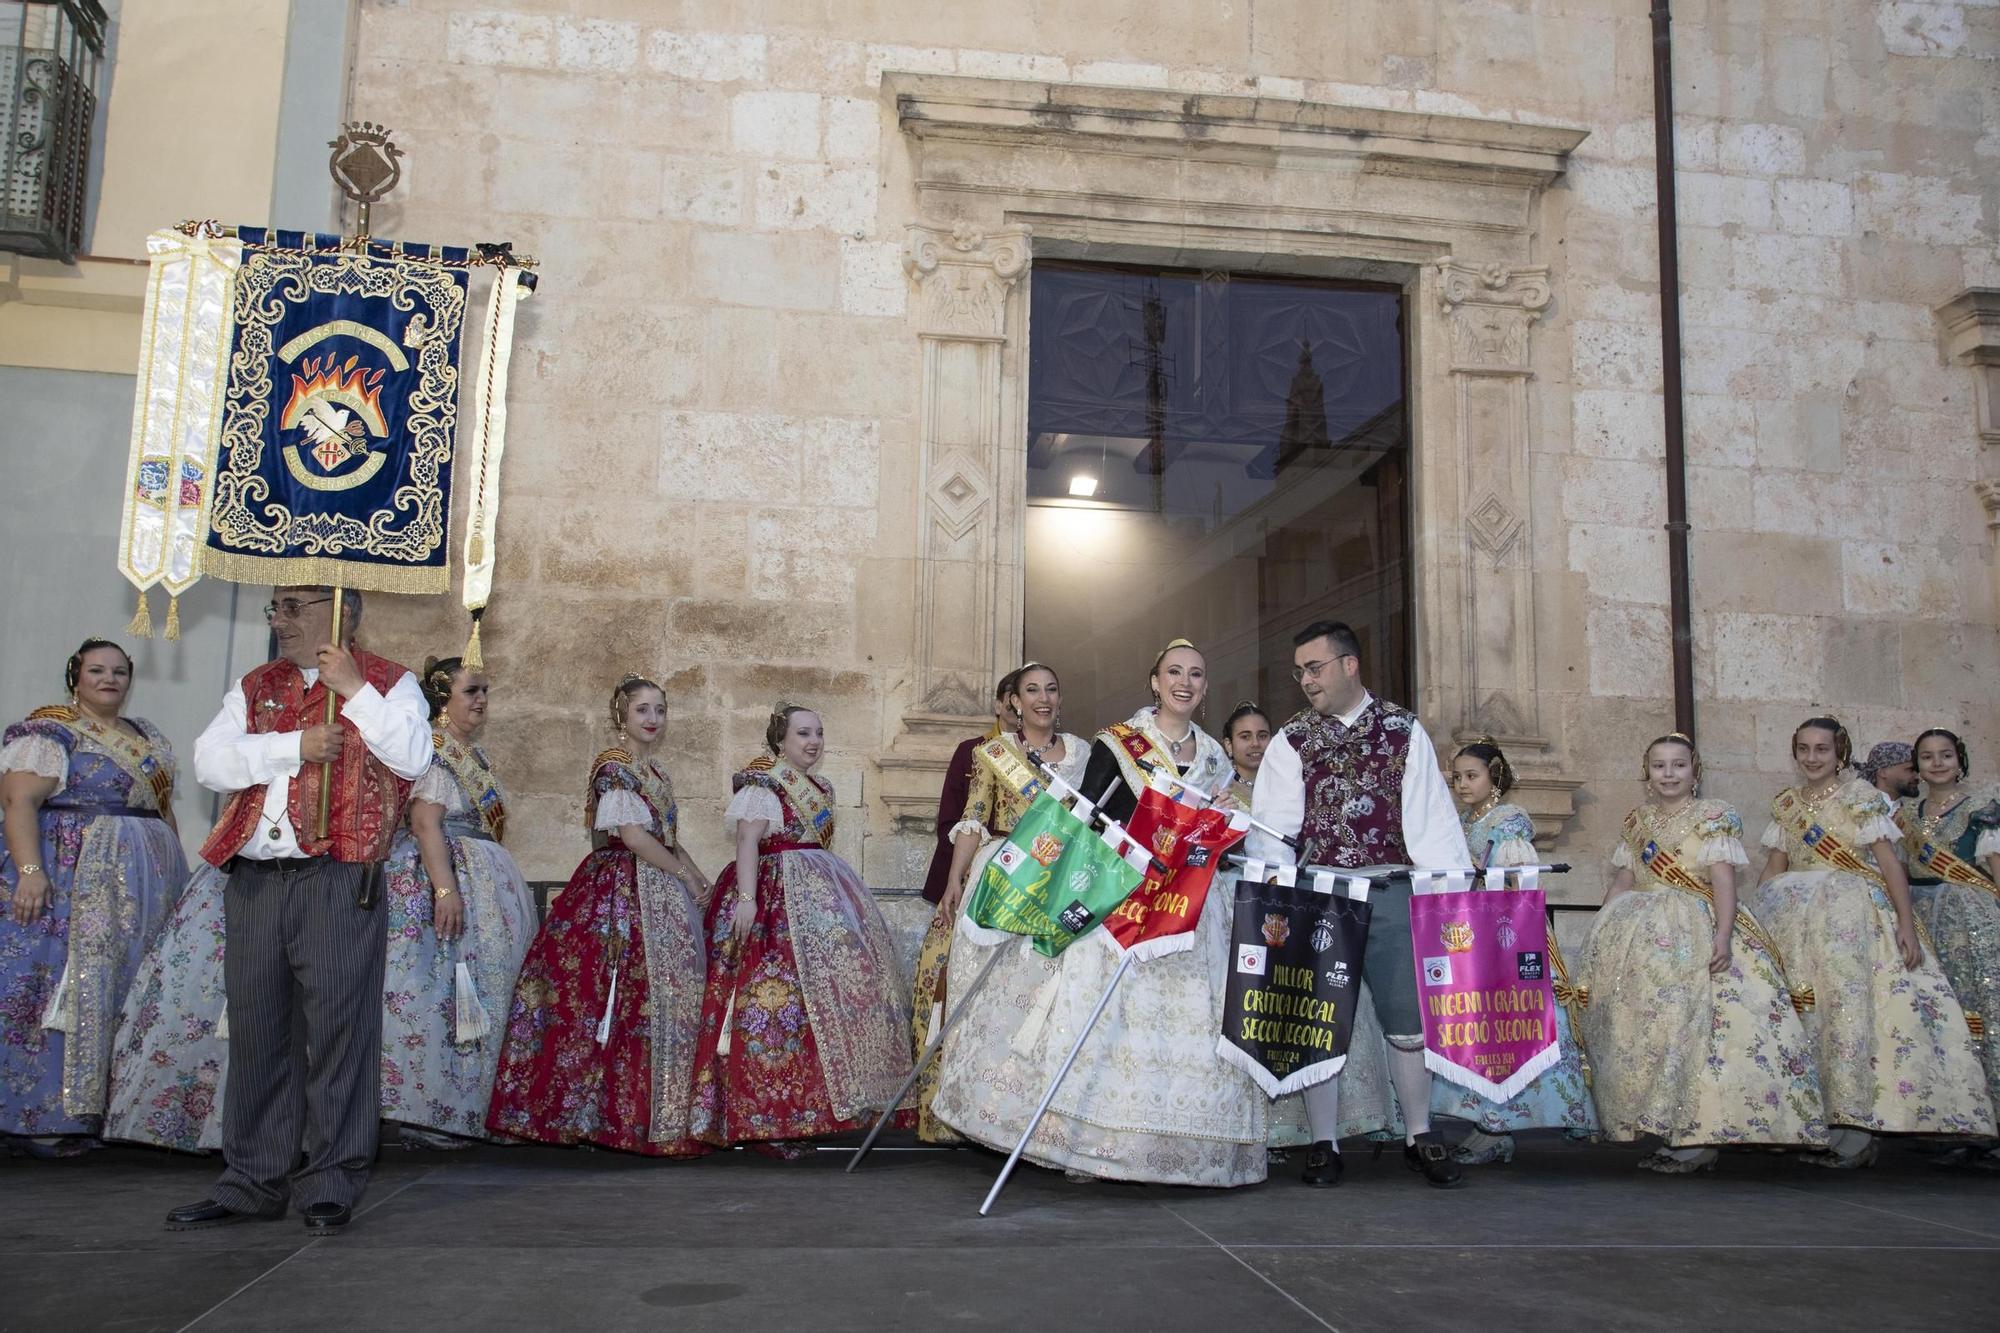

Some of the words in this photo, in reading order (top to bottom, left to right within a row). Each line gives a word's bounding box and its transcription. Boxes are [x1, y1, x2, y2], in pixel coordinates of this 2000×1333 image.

[1004, 887, 1028, 910] DE
[1062, 909, 1085, 929] FLEX
[1273, 963, 1314, 992] MILLOR
[1325, 970, 1351, 983] FLEX
[1519, 965, 1541, 973] FLEX
[1243, 985, 1291, 1016] CRÍTICA
[1292, 996, 1336, 1024] LOCAL
[1428, 990, 1482, 1017] INGENI
[1485, 990, 1492, 1012] I
[1494, 984, 1544, 1013] GRÀCIA
[1282, 1021, 1333, 1052] SEGONA
[1438, 1014, 1490, 1048] SECCIÓ
[1494, 1018, 1544, 1044] SEGONA
